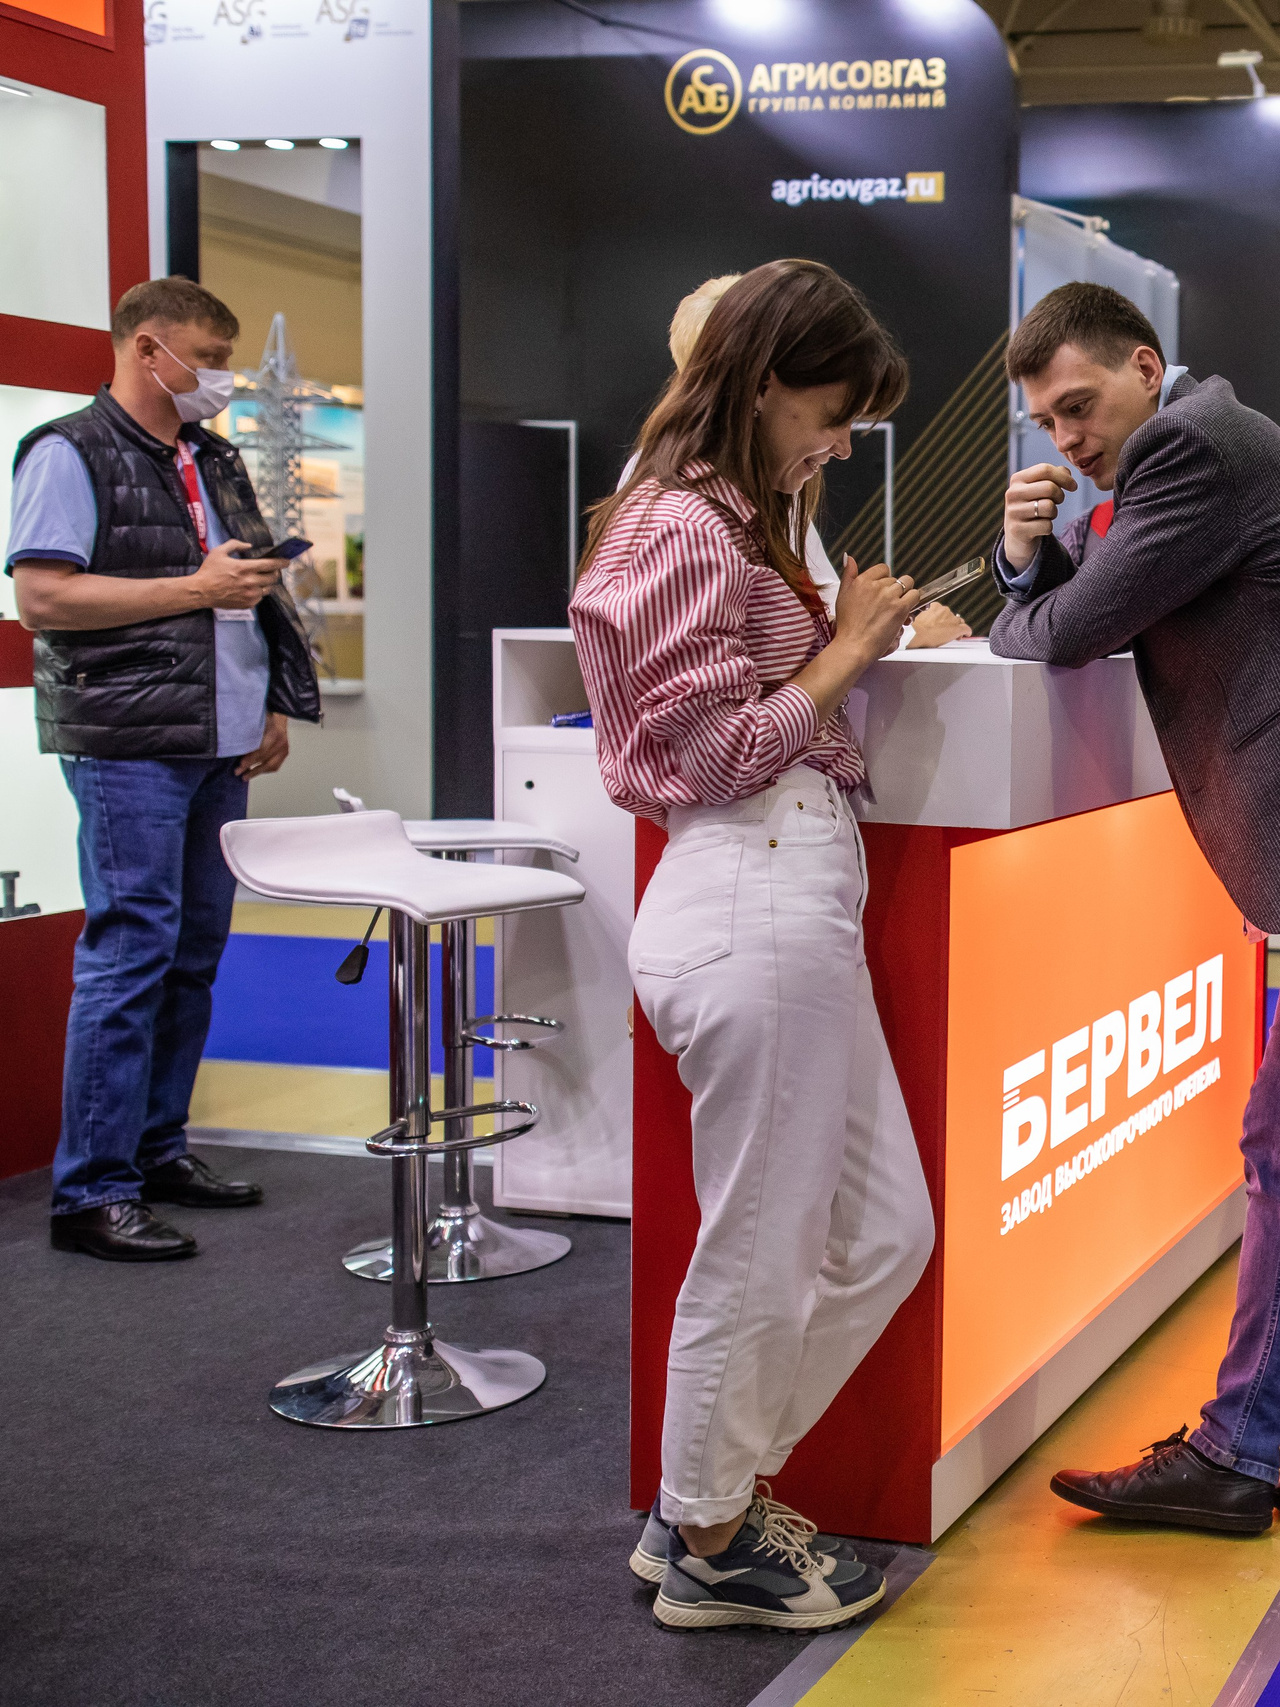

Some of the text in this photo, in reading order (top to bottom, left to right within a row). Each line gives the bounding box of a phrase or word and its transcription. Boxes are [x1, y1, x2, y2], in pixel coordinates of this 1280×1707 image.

[748, 57, 947, 93] АГРИСОВГАЗ
[748, 88, 947, 113] ГРУППА КОМПАНИЙ
[771, 172, 937, 206] agrisovgaz.ru
[1001, 953, 1223, 1182] БЕРВЕЛ
[1000, 1056, 1221, 1236] ЗАВОД ВЫСОКОПРОЧНОГО КРЕПЕЖА
